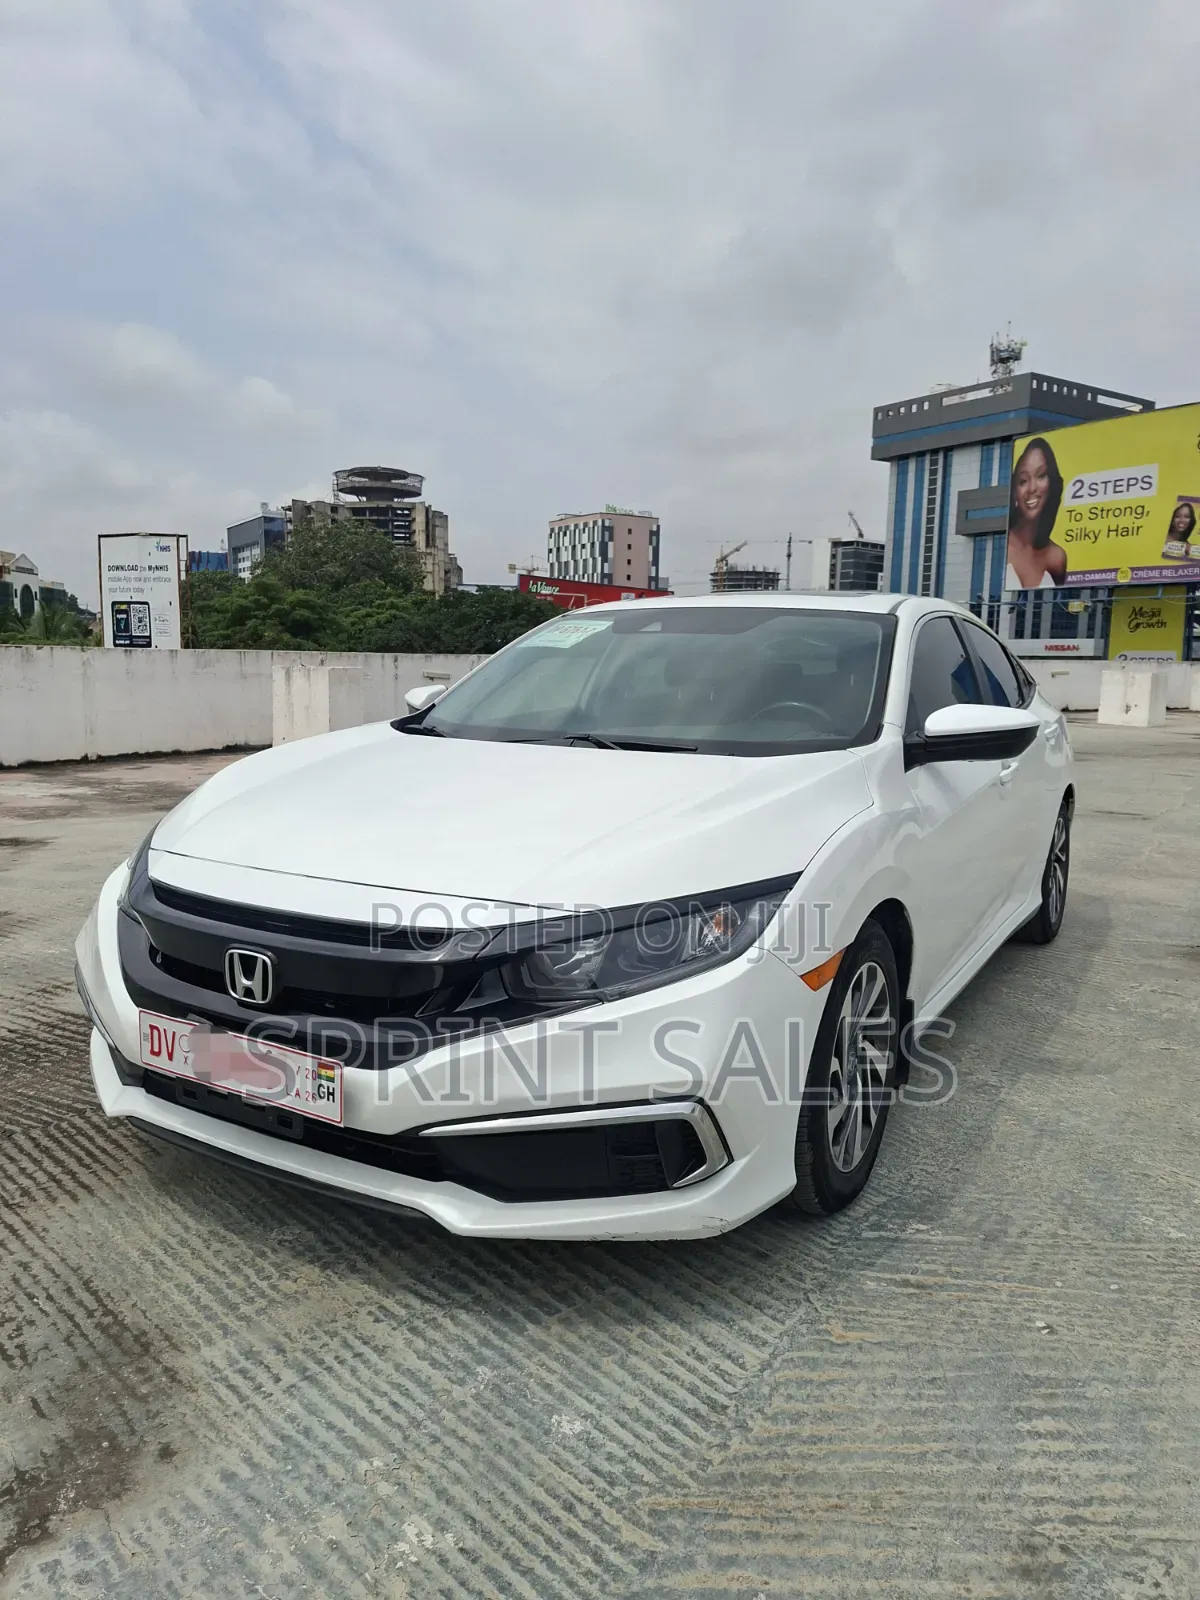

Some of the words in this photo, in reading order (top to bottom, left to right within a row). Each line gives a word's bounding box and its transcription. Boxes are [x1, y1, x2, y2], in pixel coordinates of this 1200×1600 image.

[1066, 509, 1083, 523] To
[1088, 504, 1150, 521] Strong,
[1064, 528, 1101, 544] Silky
[1106, 524, 1143, 542] Hair
[107, 564, 139, 572] DOWNLOAD
[147, 564, 169, 573] MyNHIS
[1067, 571, 1116, 582] ANTI-DAMAGE
[1162, 567, 1200, 577] RELAXER
[1128, 606, 1162, 620] Mega
[1128, 617, 1168, 633] Growth
[1044, 644, 1080, 652] NISSAN
[317, 1083, 335, 1103] GH
